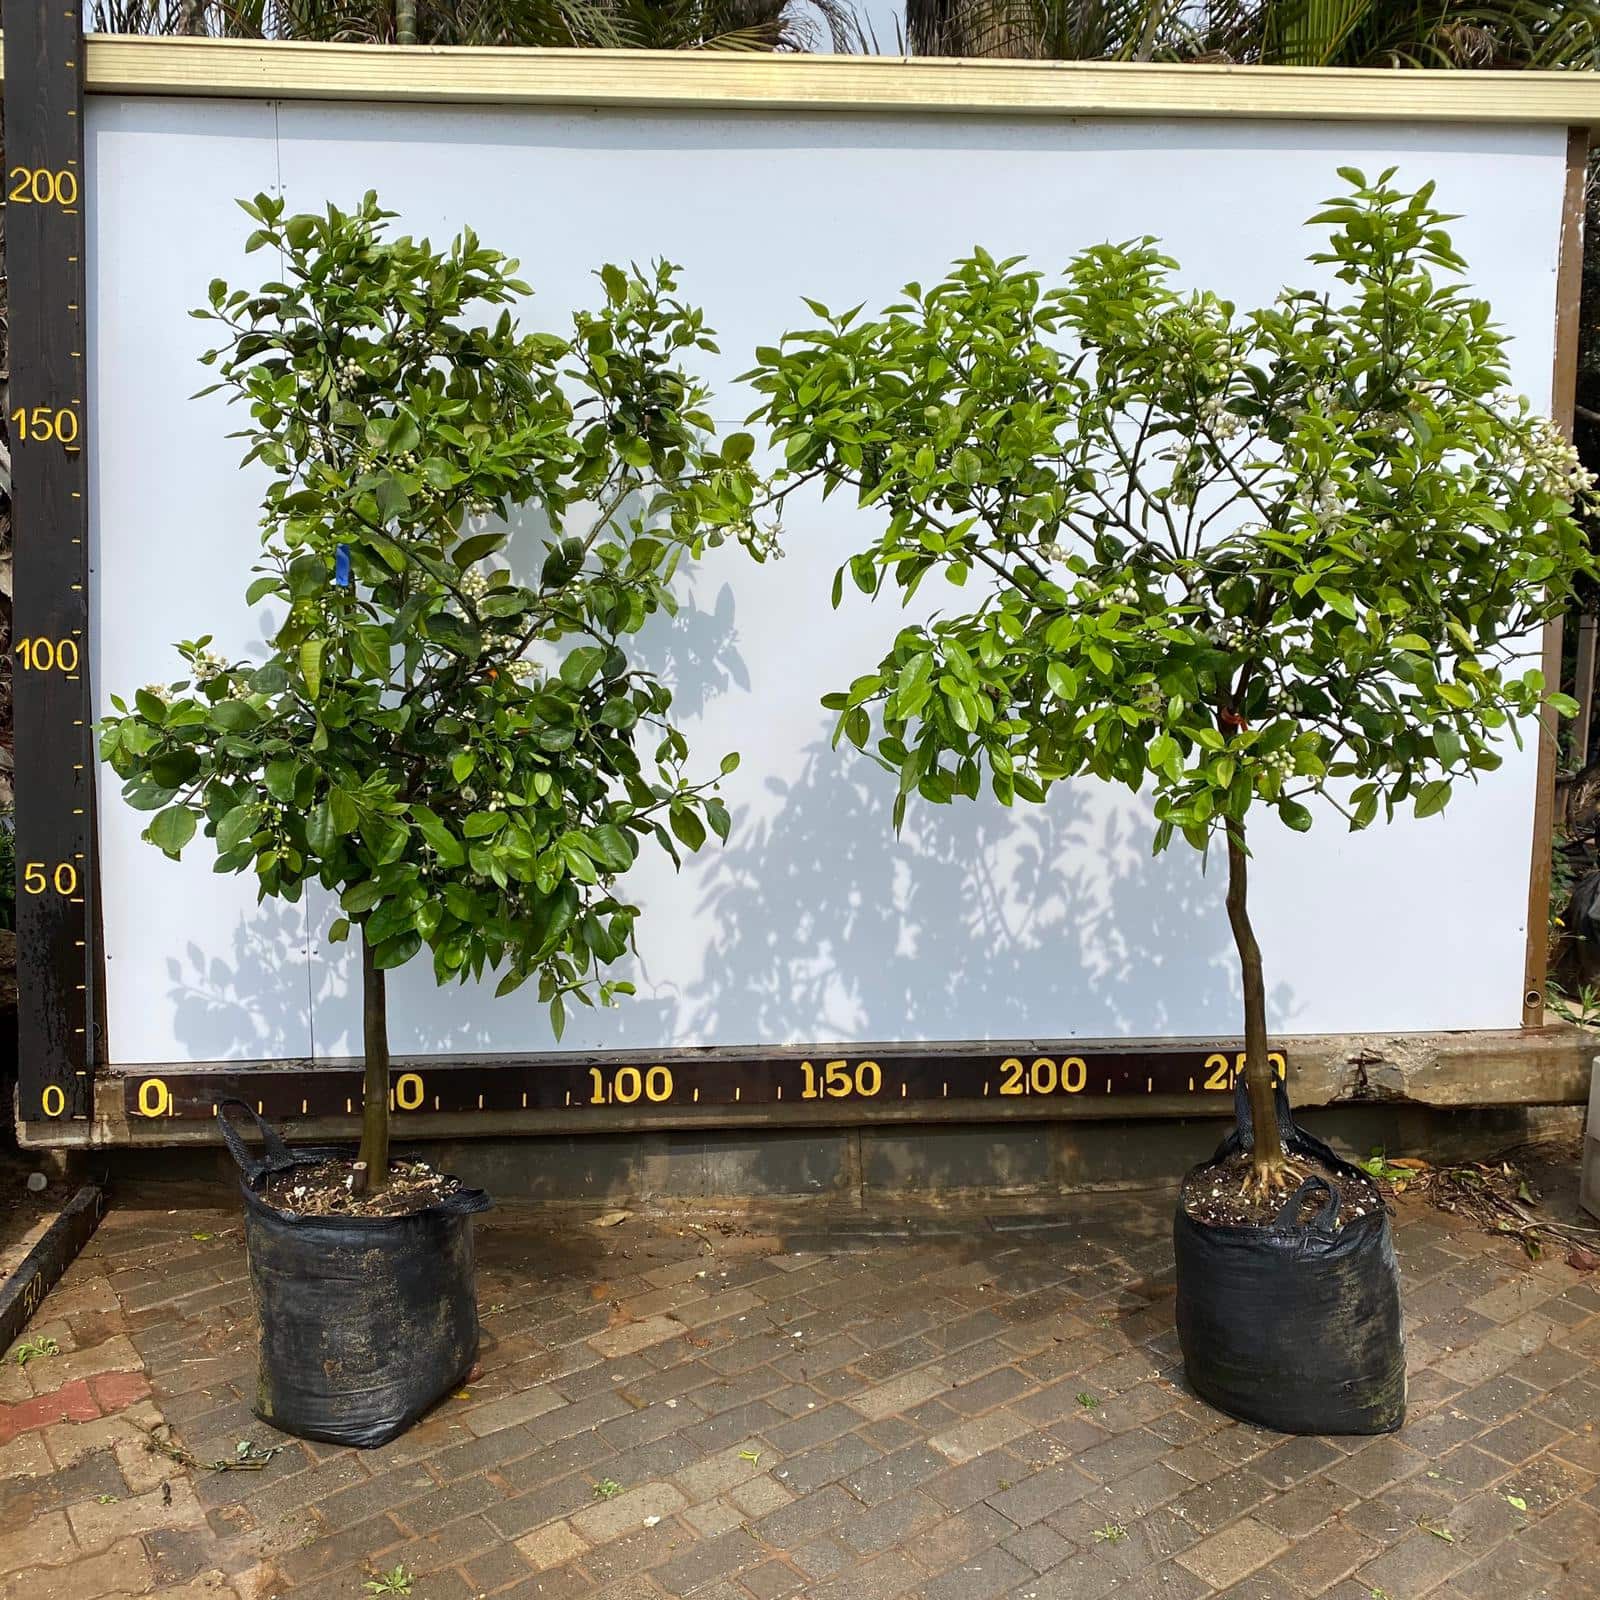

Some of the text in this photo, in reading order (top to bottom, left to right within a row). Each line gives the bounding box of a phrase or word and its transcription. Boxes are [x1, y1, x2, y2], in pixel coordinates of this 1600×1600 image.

[8, 167, 79, 206] 200
[11, 407, 79, 443] 150
[15, 637, 79, 673] 100
[23, 862, 77, 896] 50
[42, 1085, 65, 1117] 0
[138, 1078, 169, 1118] 0
[590, 1066, 674, 1104] 100
[800, 1060, 882, 1100] 150
[999, 1057, 1087, 1095] 200
